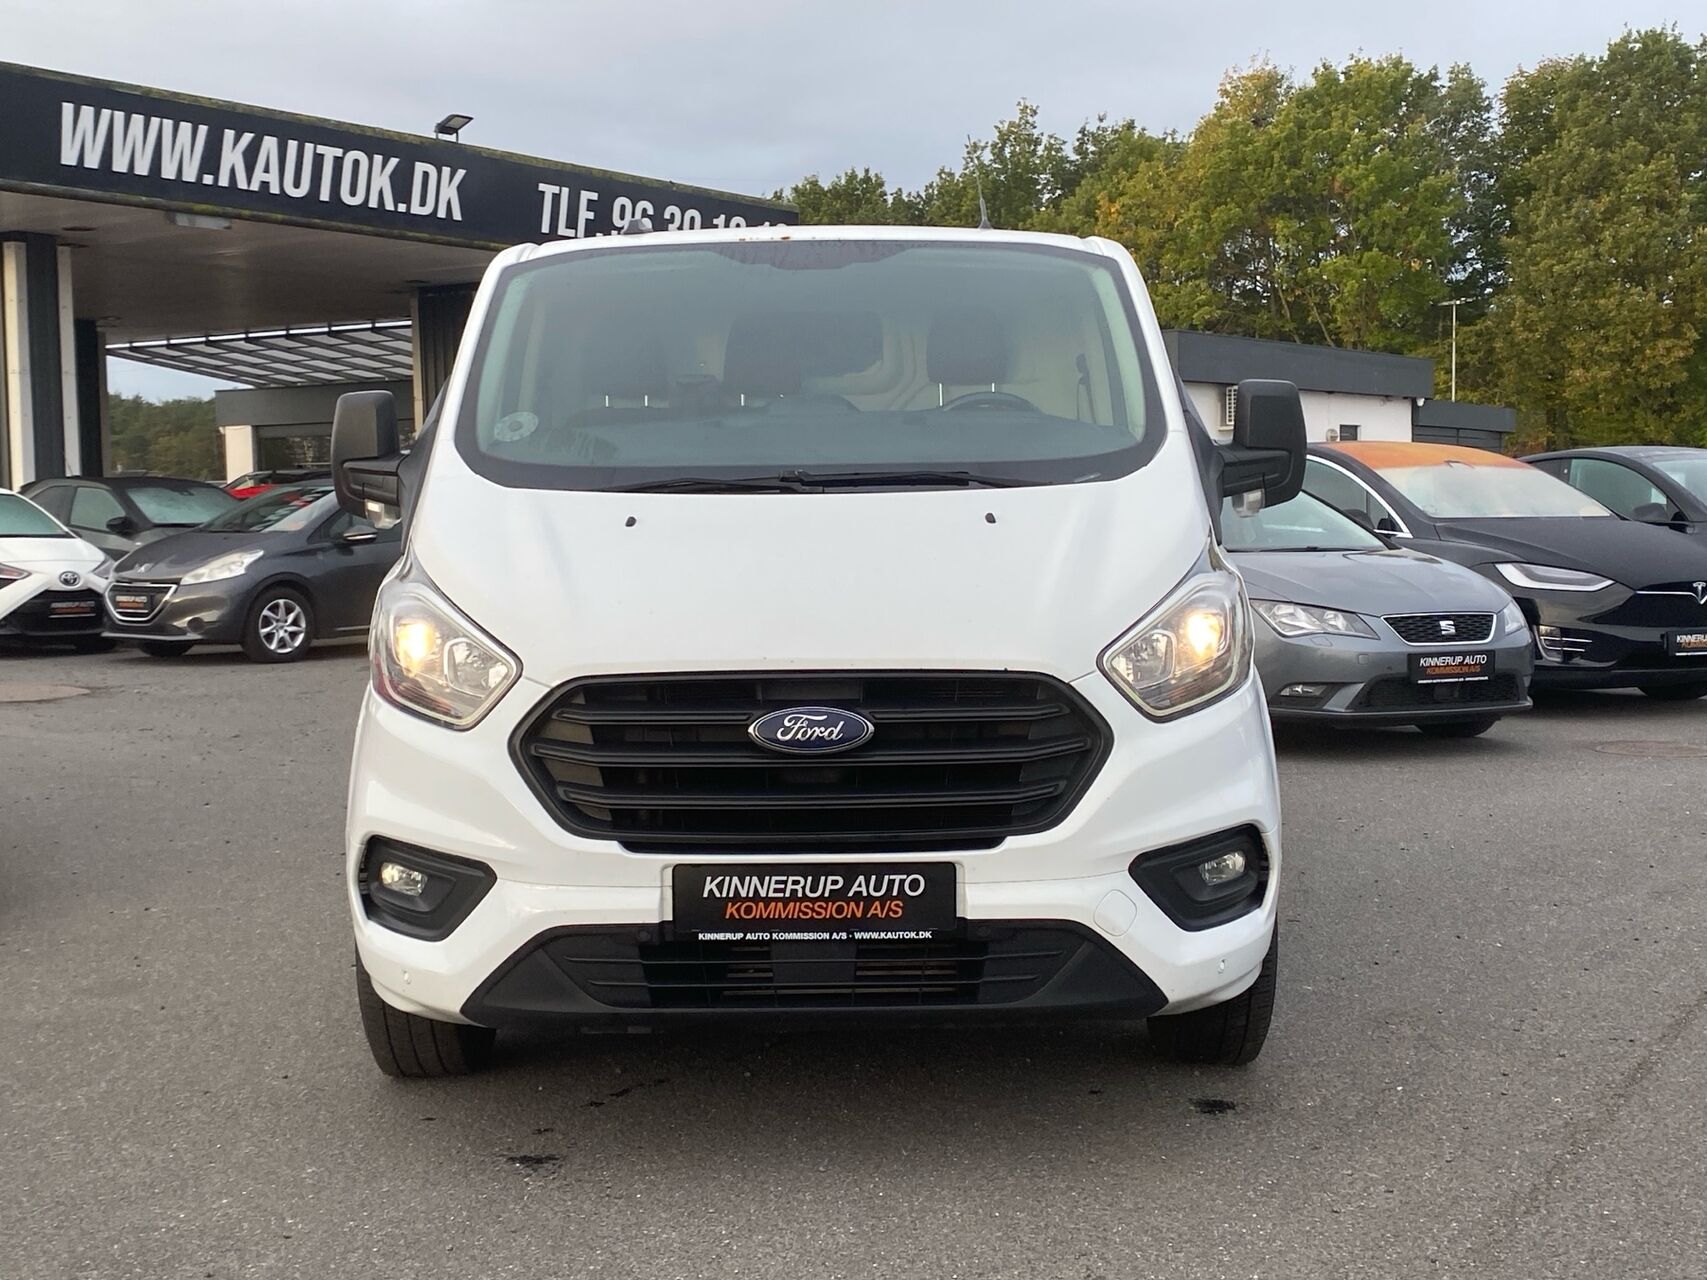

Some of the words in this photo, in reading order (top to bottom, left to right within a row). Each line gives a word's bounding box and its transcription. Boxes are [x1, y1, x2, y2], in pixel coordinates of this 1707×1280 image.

[60, 102, 467, 221] WWW.KAUTOK.DK
[1420, 656, 1464, 667] KINNERUP
[1464, 654, 1487, 665] AUTO
[776, 713, 845, 741] Ford
[703, 875, 844, 898] KINNERUP
[847, 874, 925, 897] AUTO
[725, 902, 864, 919] KOMMISSION
[867, 900, 904, 918] A/S
[698, 932, 744, 941] KINNERUP
[745, 932, 770, 941] AUTO
[772, 931, 829, 940] KOMMISSION
[831, 931, 847, 940] A/S
[854, 930, 932, 940] WWW.KAUTOK.DK
